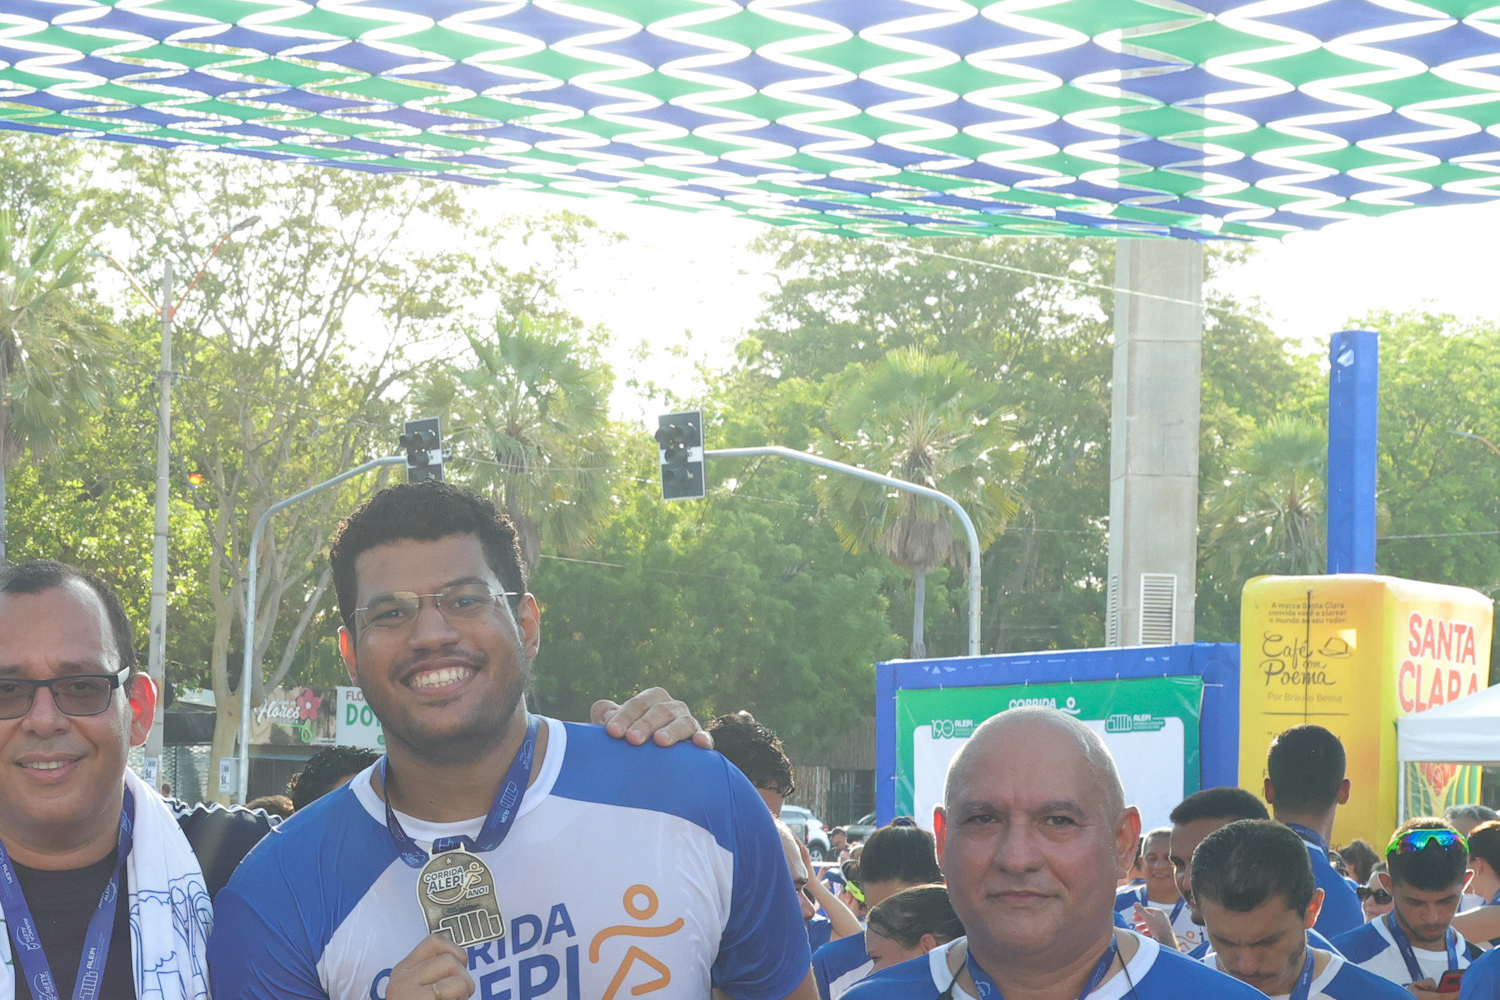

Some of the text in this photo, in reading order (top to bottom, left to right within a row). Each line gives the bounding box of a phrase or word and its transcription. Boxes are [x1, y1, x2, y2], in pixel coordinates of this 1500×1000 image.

[1262, 631, 1314, 669] Café
[1408, 612, 1476, 666] SANTA
[1259, 658, 1337, 686] Poema
[425, 867, 463, 882] CORRIDA
[428, 874, 464, 893] ALEPI
[86, 947, 96, 970] ALEPI
